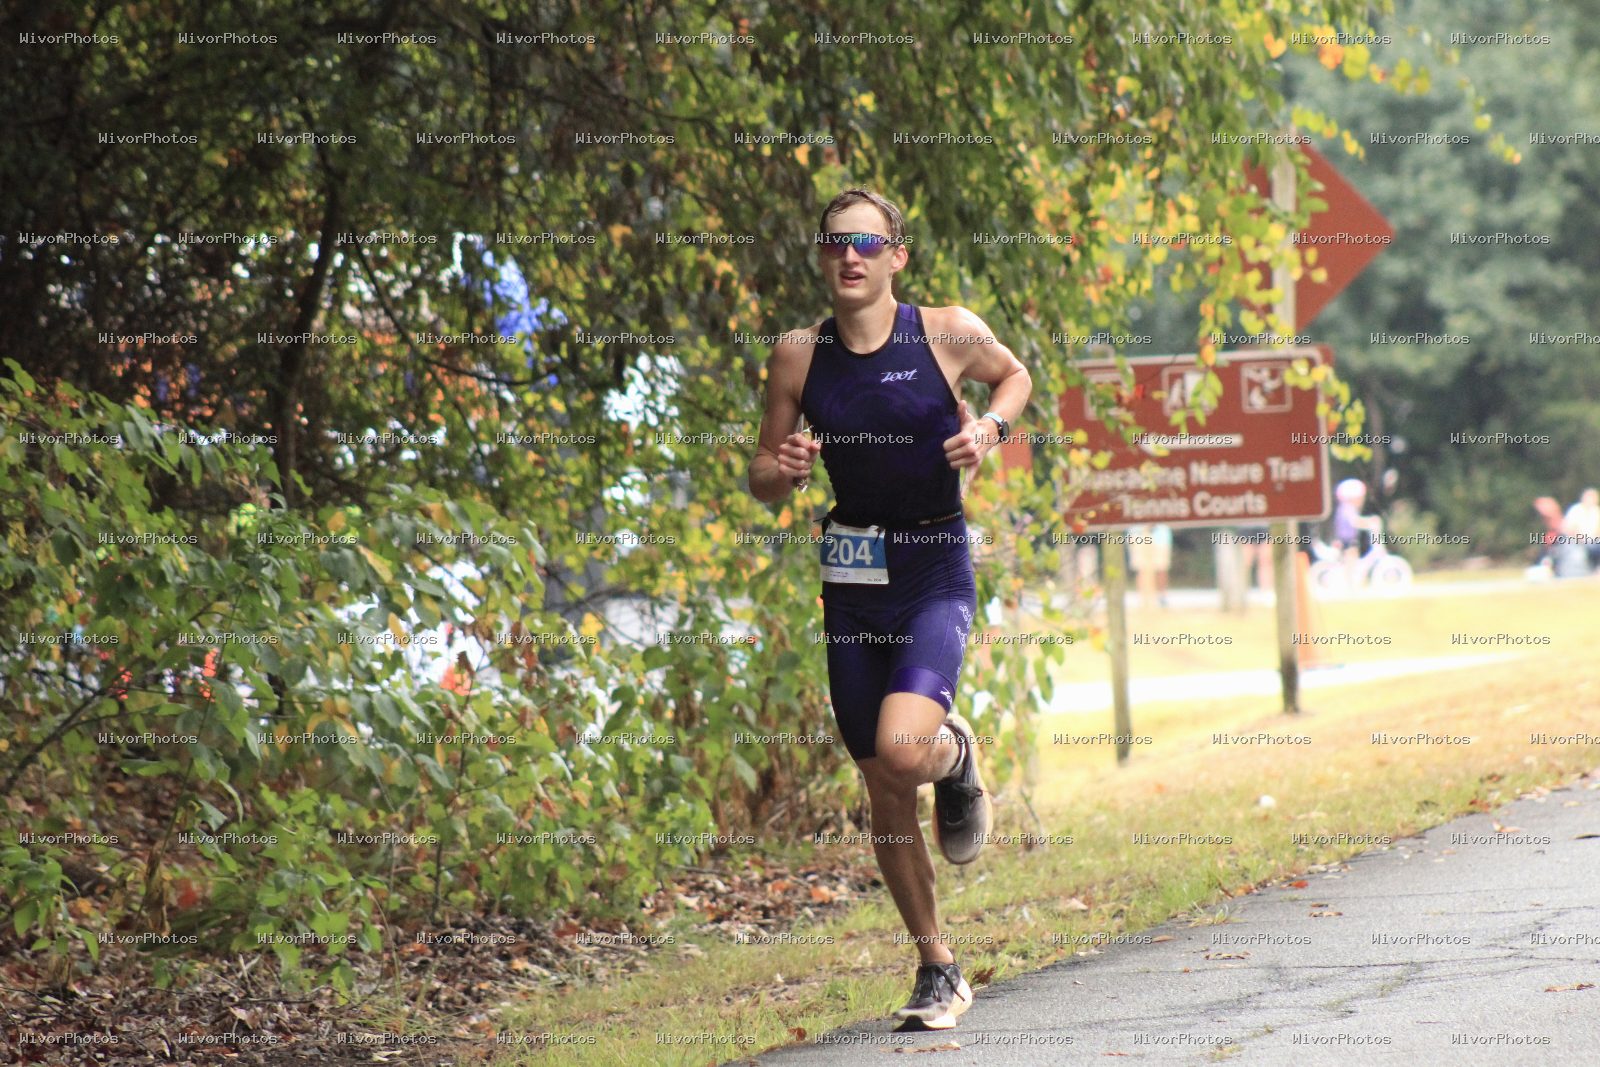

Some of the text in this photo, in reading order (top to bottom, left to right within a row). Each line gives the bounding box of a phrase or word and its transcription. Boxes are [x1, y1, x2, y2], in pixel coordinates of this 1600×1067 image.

[1189, 460, 1264, 485] Nature
[1266, 456, 1315, 482] Trail
[1121, 490, 1268, 518] Tennis Courts
[826, 537, 874, 566] 204
